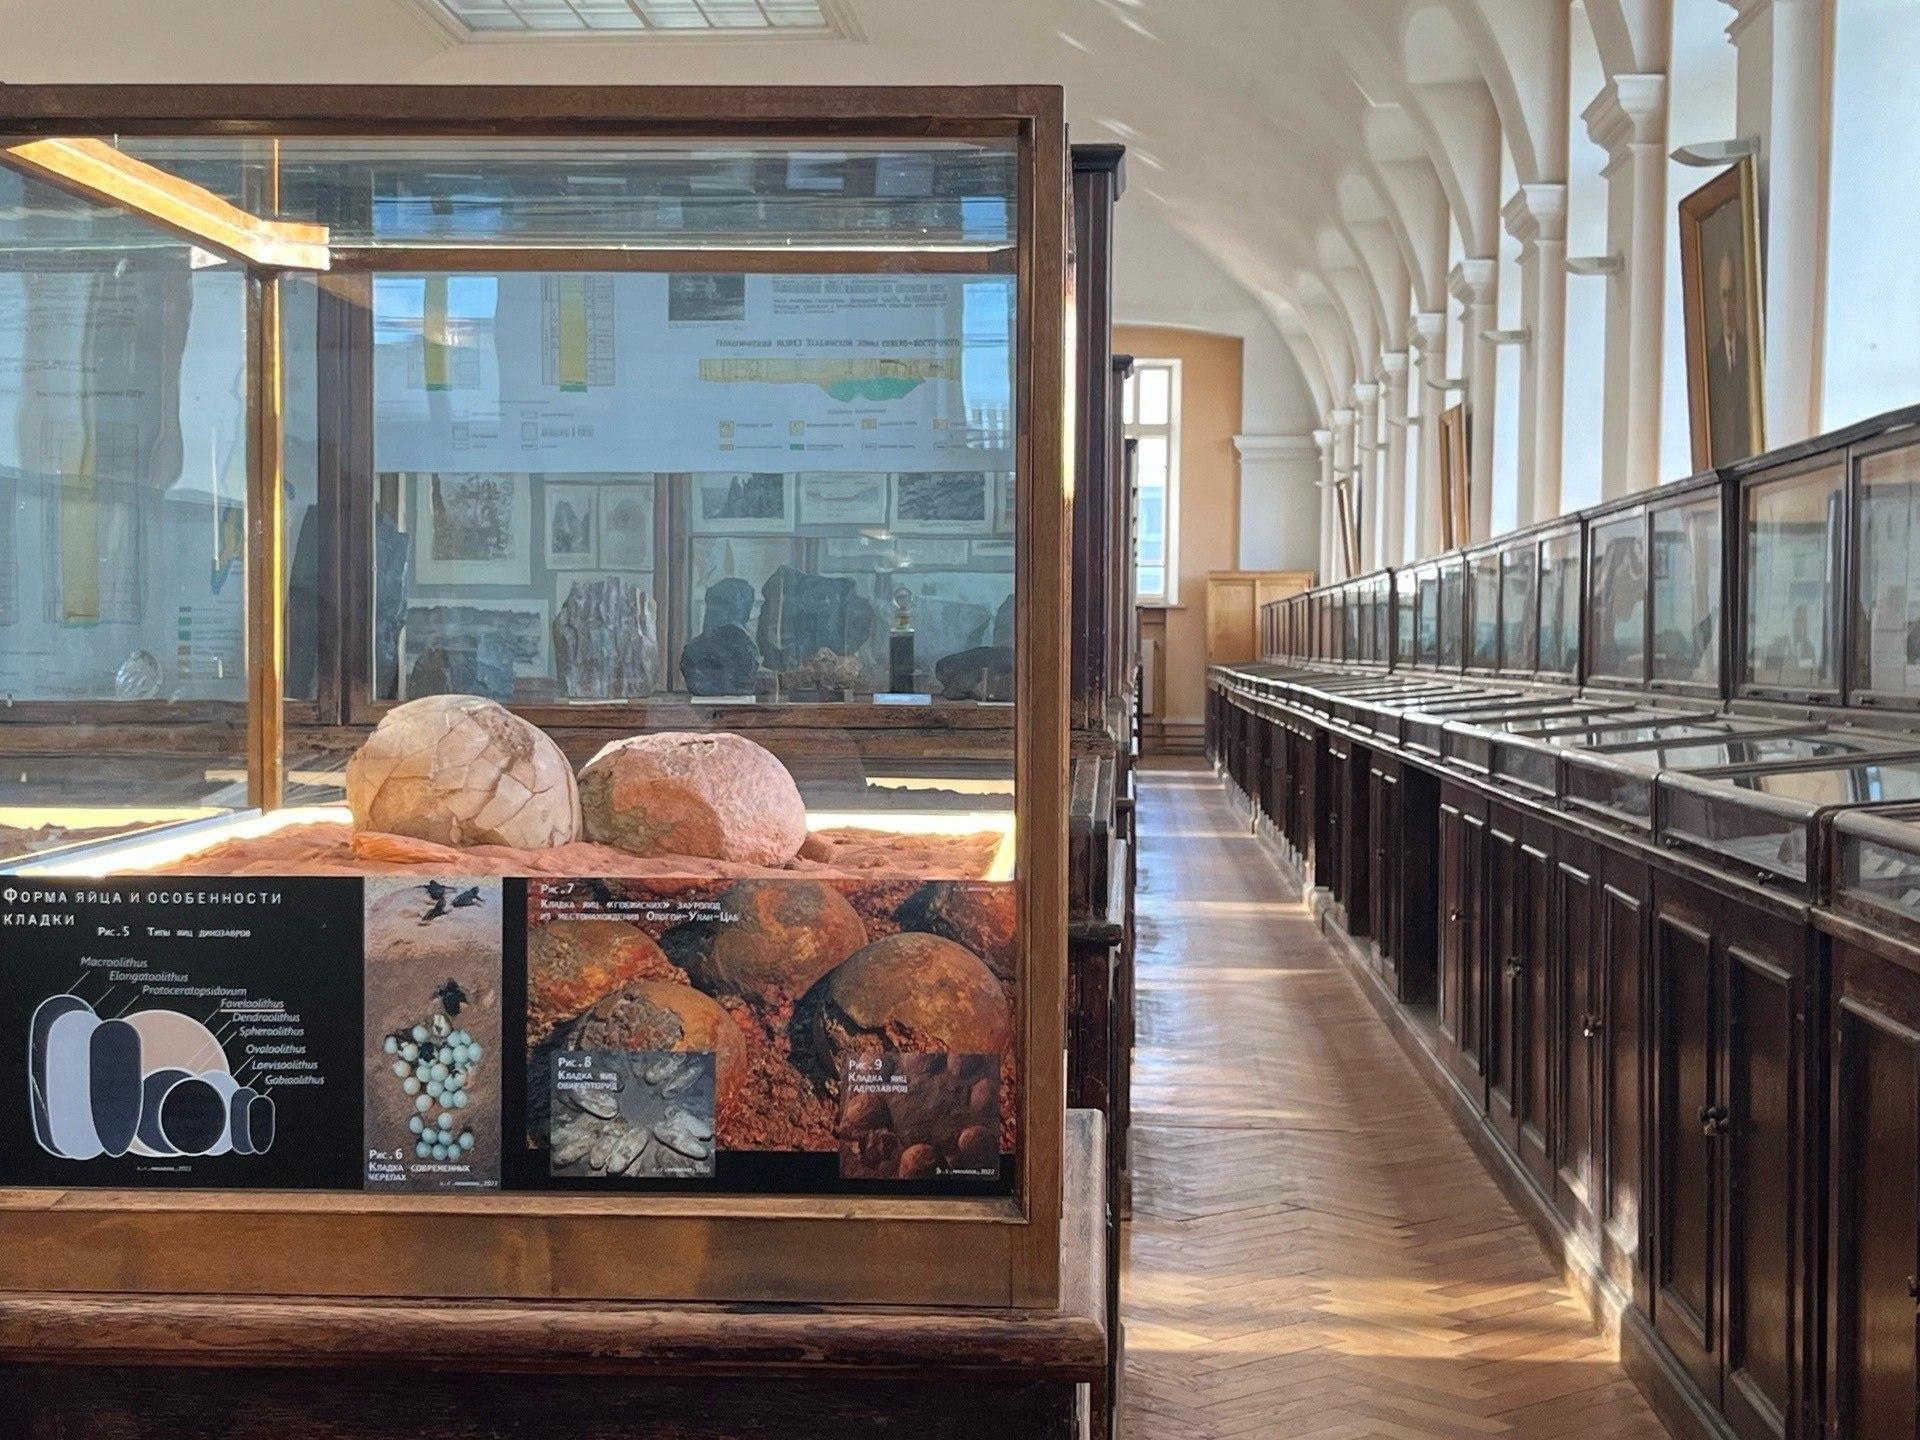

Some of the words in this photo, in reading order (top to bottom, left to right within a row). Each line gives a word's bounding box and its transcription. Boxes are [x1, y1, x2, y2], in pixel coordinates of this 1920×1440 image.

[75, 889, 122, 906] ЯЙЦА
[129, 892, 141, 904] И
[147, 891, 282, 905] ОСОБЕННОСТИ
[2, 912, 76, 927] КЛАДКИ
[79, 956, 149, 969] Macroolithus
[109, 971, 189, 984] Elongatoolithus
[142, 985, 248, 998] Protoceratopsidovum
[232, 1012, 301, 1023] Dendroolithus
[239, 1026, 305, 1038] Spheroolithus
[245, 1043, 307, 1055] Ovaloolithus
[252, 1060, 319, 1071] Laevisoolithus
[264, 1074, 325, 1086] Gobioolithus
